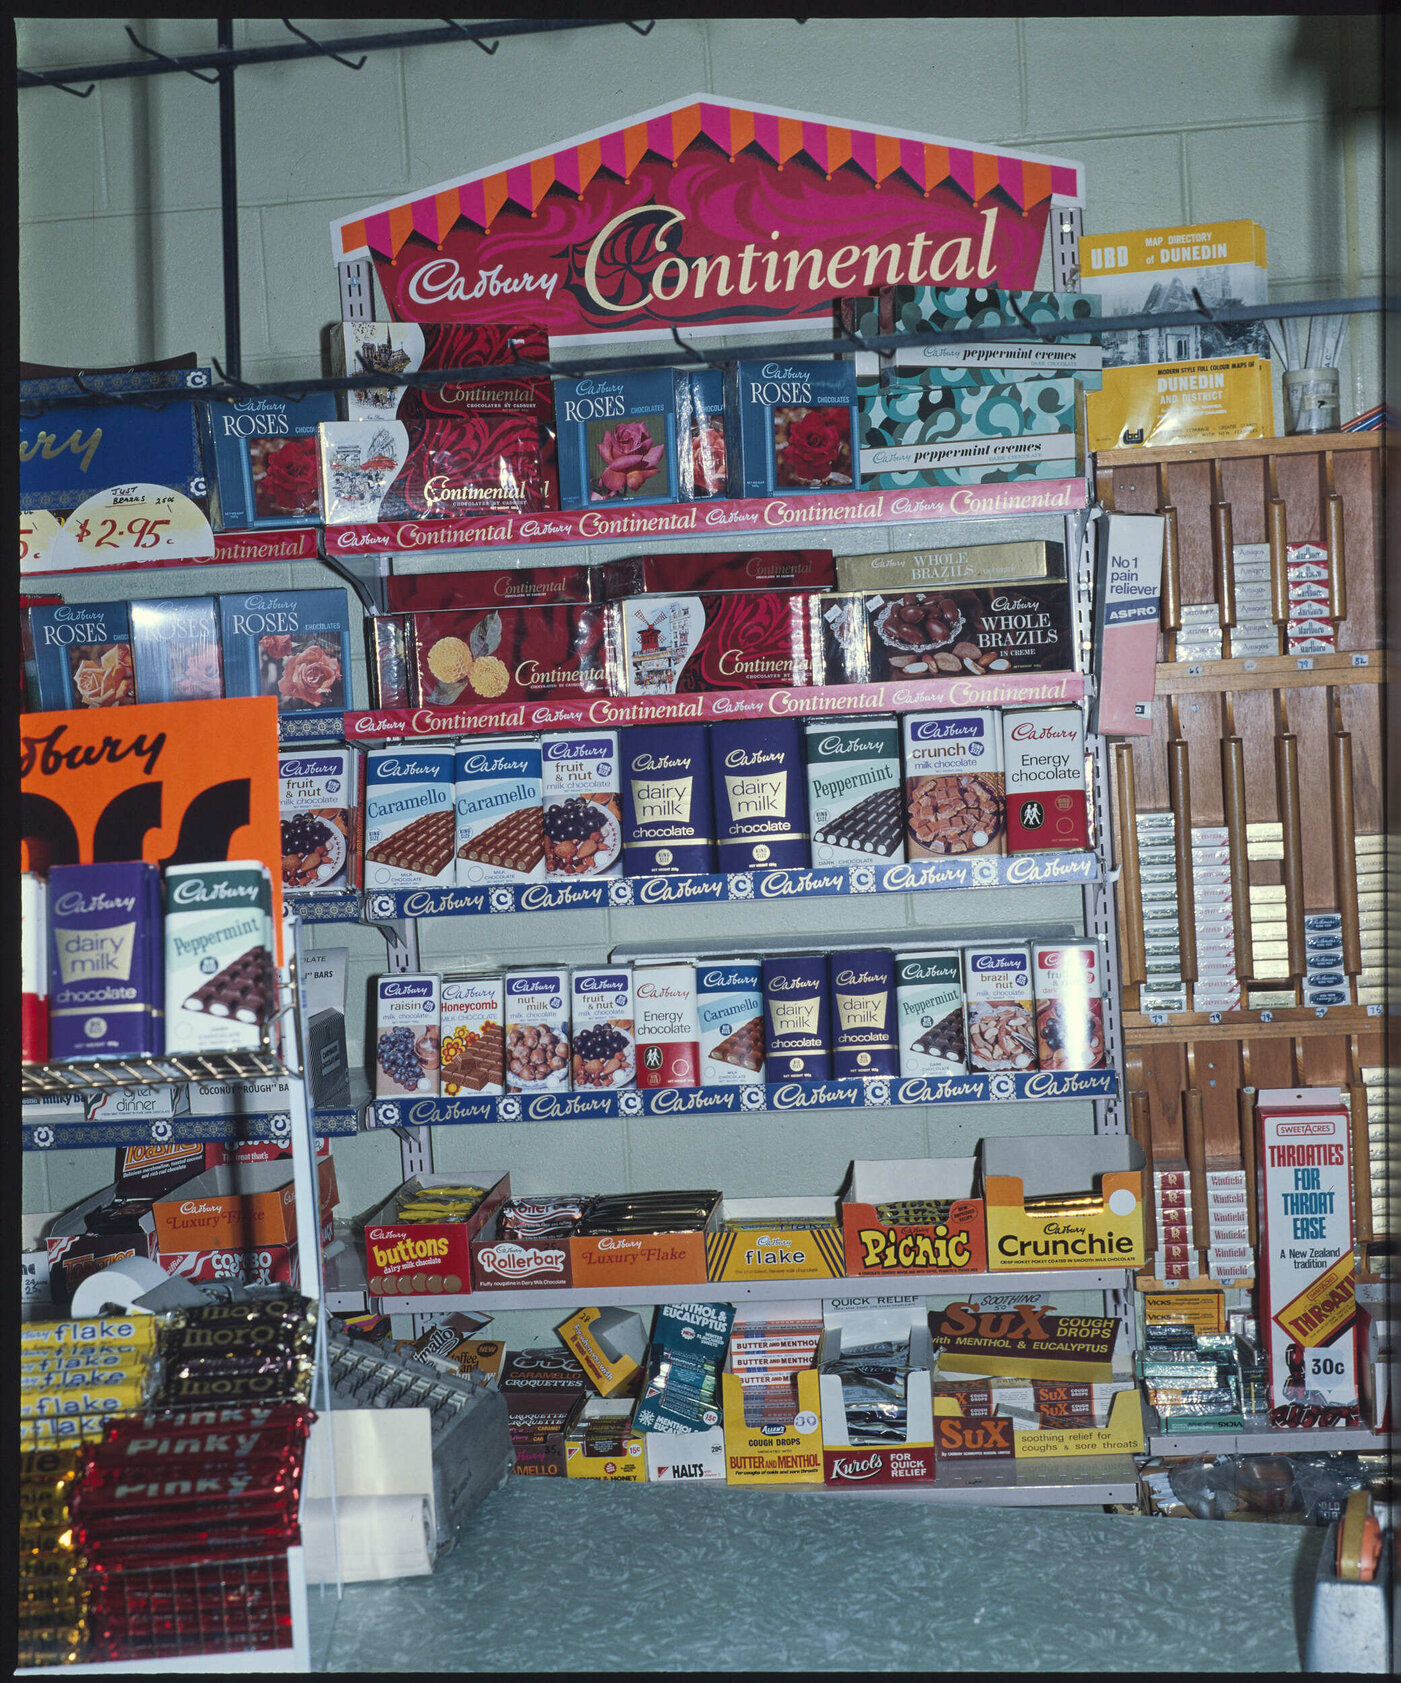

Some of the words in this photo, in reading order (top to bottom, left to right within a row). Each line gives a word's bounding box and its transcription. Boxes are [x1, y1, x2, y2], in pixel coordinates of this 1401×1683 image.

[408, 258, 558, 304] Cadbury
[584, 204, 999, 312] Continental
[1091, 246, 1129, 270] UBD
[1168, 232, 1212, 244] DIRECTORY
[1146, 255, 1155, 264] of
[1160, 243, 1228, 264] DUNEDIN
[963, 342, 1032, 361] peppermint
[1034, 352, 1077, 361] cremes
[1158, 368, 1180, 376] MODERN
[1181, 366, 1196, 375] STYLE
[1197, 365, 1208, 373] FULL
[1231, 361, 1247, 369] MAPS
[1157, 373, 1225, 393] DUNEDIN
[751, 381, 812, 406] ROSES
[817, 396, 850, 404] CHOCOLATES
[565, 395, 625, 423] ROSES
[630, 404, 665, 414] CHOCOLATES
[222, 413, 289, 438] ROSES
[914, 446, 990, 463] peppermint
[993, 442, 1042, 454] cremes
[111, 487, 138, 496] JUST
[397, 519, 513, 548] Continental
[579, 507, 697, 538] Continental
[764, 496, 884, 527] Continental
[950, 485, 1072, 515] Continental
[913, 552, 968, 567] WHOLE
[1111, 556, 1130, 568] No
[911, 566, 975, 581] BRAZILS
[1111, 569, 1138, 583] pain
[1110, 581, 1158, 595] reliever
[1109, 606, 1156, 620] ASPRO
[232, 612, 299, 637] ROSES
[305, 622, 341, 631] CHOCOLATES
[981, 612, 1051, 632] WHOLE
[43, 622, 107, 647] ROSES
[977, 629, 1059, 649] BRAZILS
[1010, 648, 1036, 656] CREME
[412, 706, 526, 733] Continental
[589, 695, 704, 724] Continental
[768, 688, 885, 715] Continental
[949, 678, 1068, 706] Continental
[918, 721, 978, 740] Cadbury
[1011, 722, 1078, 741] Cadbury
[548, 742, 607, 760] Cadbury
[818, 735, 884, 756] Cadbury
[912, 743, 966, 759] crunch
[464, 755, 528, 774] Cadbury
[631, 753, 691, 772] Cadbury
[725, 749, 785, 769] Cadbury
[915, 761, 932, 770] milk
[934, 758, 977, 768] chocolate
[1021, 754, 1070, 768] Energy
[376, 758, 441, 778] Cadbury
[555, 762, 585, 773] fruit
[1011, 768, 1081, 783] chocolate
[286, 778, 314, 791] fruit
[555, 774, 564, 782] &
[568, 771, 592, 781] nut
[812, 764, 893, 799] Peppermint
[298, 787, 322, 798] nut
[566, 780, 611, 790] chocolate
[637, 780, 686, 801] dairy
[732, 775, 781, 796] dairy
[368, 788, 446, 819] Caramello
[457, 784, 536, 816] Caramello
[737, 796, 778, 812] milk
[642, 800, 681, 817] milk
[632, 825, 695, 839] chocolate
[729, 821, 791, 835] chocolate
[403, 891, 484, 917] Cadbury
[521, 884, 603, 911] Cadbury
[640, 877, 722, 904] Cadbury
[760, 872, 843, 898] Cadbury
[883, 863, 967, 890] Cadbury
[1006, 857, 1092, 884] Cadbury
[65, 934, 125, 955] dairy
[173, 917, 261, 956] Peppermint
[70, 954, 120, 973] milk
[314, 970, 333, 979] BARS
[980, 973, 1009, 982] brazil
[996, 980, 1014, 989] nut
[57, 986, 137, 1002] chocolate
[517, 996, 535, 1005] nut
[583, 993, 605, 1004] fruit
[390, 1001, 421, 1011] raisin
[441, 1000, 498, 1013] Honeycomb
[596, 1001, 614, 1010] nut
[703, 997, 759, 1024] Caramello
[843, 997, 881, 1014] dairy
[903, 990, 959, 1016] Peppermint
[643, 1010, 684, 1023] Energy
[775, 1003, 814, 1020] dairy
[847, 1012, 879, 1025] milk
[637, 1021, 691, 1035] chocolate
[780, 1016, 811, 1030] milk
[771, 1036, 822, 1049] chocolate
[116, 1098, 156, 1112] dinner
[408, 1100, 491, 1125] Cadbury
[529, 1094, 612, 1120] Cadbury
[1268, 1144, 1344, 1167] THROATIES
[1294, 1168, 1320, 1190] FOR
[1282, 1192, 1335, 1216] THROAT
[166, 1212, 219, 1230] Luxury
[1293, 1217, 1326, 1240] EASE
[372, 1237, 449, 1268] buttons
[858, 1224, 972, 1269] Picnic
[997, 1232, 1134, 1257] Crunchie
[210, 1250, 273, 1270] COMBO
[582, 1249, 639, 1265] Luxury
[640, 1248, 686, 1263] Flake
[745, 1249, 806, 1265] flake
[1280, 1249, 1286, 1258] A
[1289, 1249, 1307, 1258] New
[1309, 1248, 1340, 1258] Zealand
[481, 1251, 564, 1275] Rollerbar
[1294, 1259, 1327, 1269] tradition
[831, 1297, 870, 1308] QUICK
[877, 1295, 919, 1304] RELIEF
[662, 1308, 728, 1333] EUCALYPTUS
[1058, 1317, 1114, 1328] COUGH
[1056, 1327, 1112, 1339] DROPS
[736, 1342, 768, 1350] BUTTER
[780, 1339, 819, 1348] MENTHOL
[955, 1337, 1012, 1349] MENTHOL
[1017, 1341, 1026, 1350] &
[1032, 1341, 1108, 1353] EUCALYPTUS
[737, 1358, 768, 1366] BUTTER
[1311, 1358, 1345, 1375] 30c
[505, 1379, 583, 1388] CROQUETTES
[509, 1371, 582, 1380] CARAMELLO
[740, 1376, 770, 1384] BUTTER
[748, 1439, 773, 1447] COUGH
[776, 1438, 800, 1446] DROPS
[1021, 1433, 1065, 1444] soothing
[1069, 1432, 1093, 1441] relief
[1096, 1432, 1112, 1440] for
[1021, 1443, 1058, 1453] coughs
[1102, 1440, 1138, 1449] throats
[730, 1455, 764, 1470] BUTTER
[777, 1453, 821, 1469] MENTHOL
[890, 1453, 911, 1462] FOR
[890, 1461, 925, 1470] QUICK
[672, 1463, 704, 1478] HALTS
[891, 1468, 927, 1478] RELIEF
